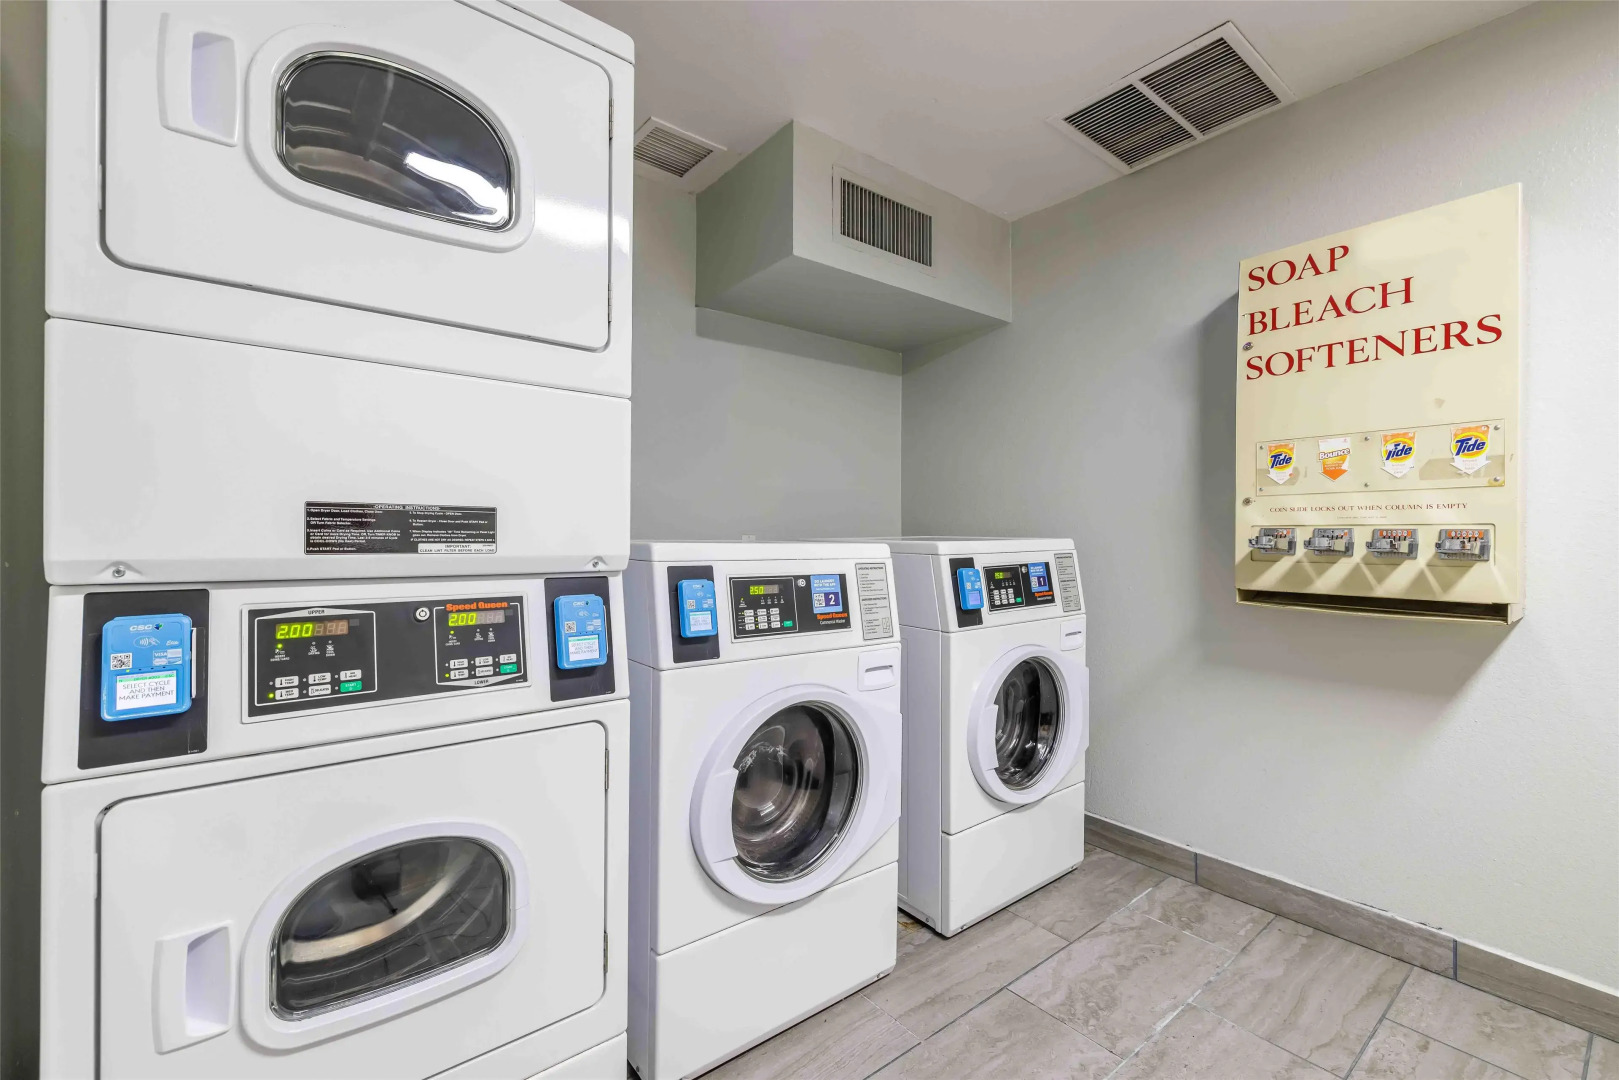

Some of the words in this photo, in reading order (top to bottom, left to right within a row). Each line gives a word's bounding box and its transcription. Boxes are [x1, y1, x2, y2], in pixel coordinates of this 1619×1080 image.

[1248, 245, 1349, 292] SOAP
[1247, 276, 1414, 336] BLEACH
[1246, 314, 1502, 380] SOFTENERS
[1319, 448, 1350, 460] Bounce
[1455, 437, 1486, 456] Tide
[1270, 453, 1292, 469] Tide
[446, 602, 477, 612] Speed
[829, 594, 835, 605] 2
[449, 613, 476, 626] 2.00
[276, 624, 313, 639] 2.00
[141, 690, 174, 698] PAYMENT
